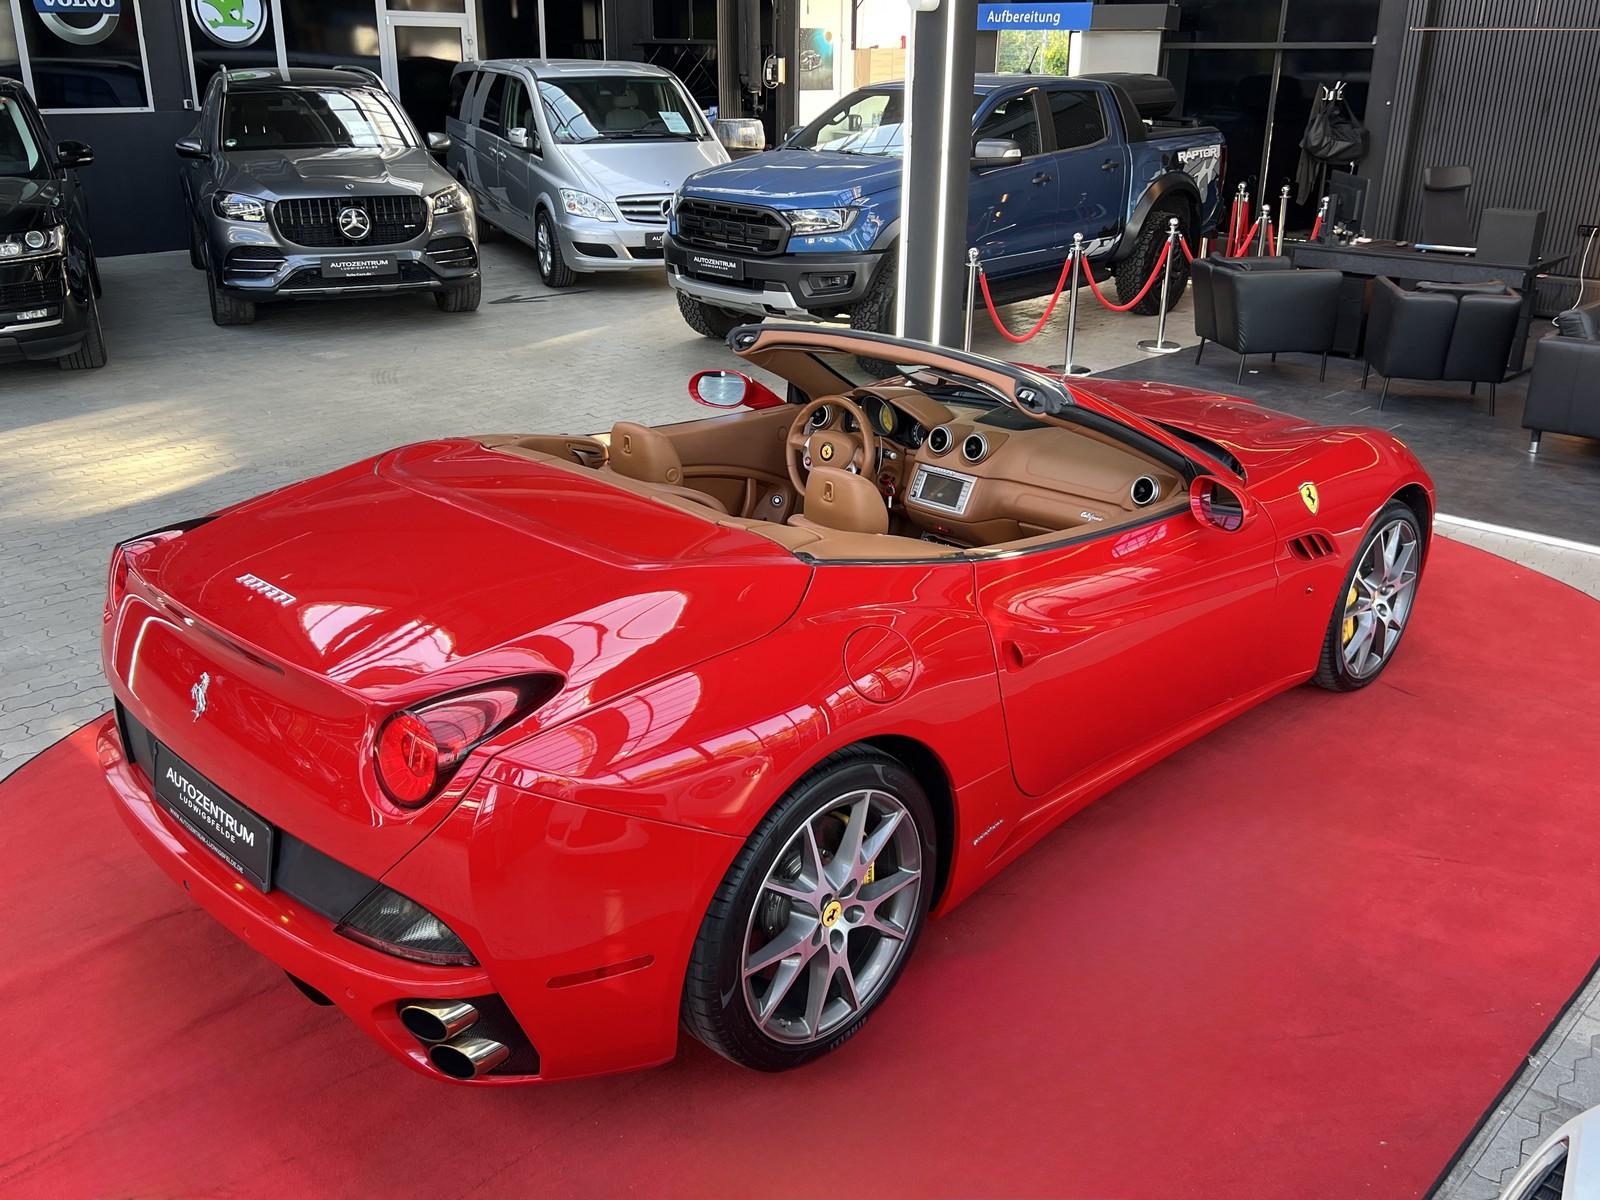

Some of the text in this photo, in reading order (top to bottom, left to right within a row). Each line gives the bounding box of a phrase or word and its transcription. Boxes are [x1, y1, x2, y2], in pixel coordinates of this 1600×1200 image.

[986, 10, 1061, 26] Aufbereitung
[1177, 147, 1218, 164] RAPTOR
[330, 259, 389, 268] AUTOZENTRUM
[693, 256, 737, 269] AUTOZENTRUM
[165, 766, 255, 848] AUTOZENTRUM
[179, 792, 236, 845] LUDWIGSFELDE
